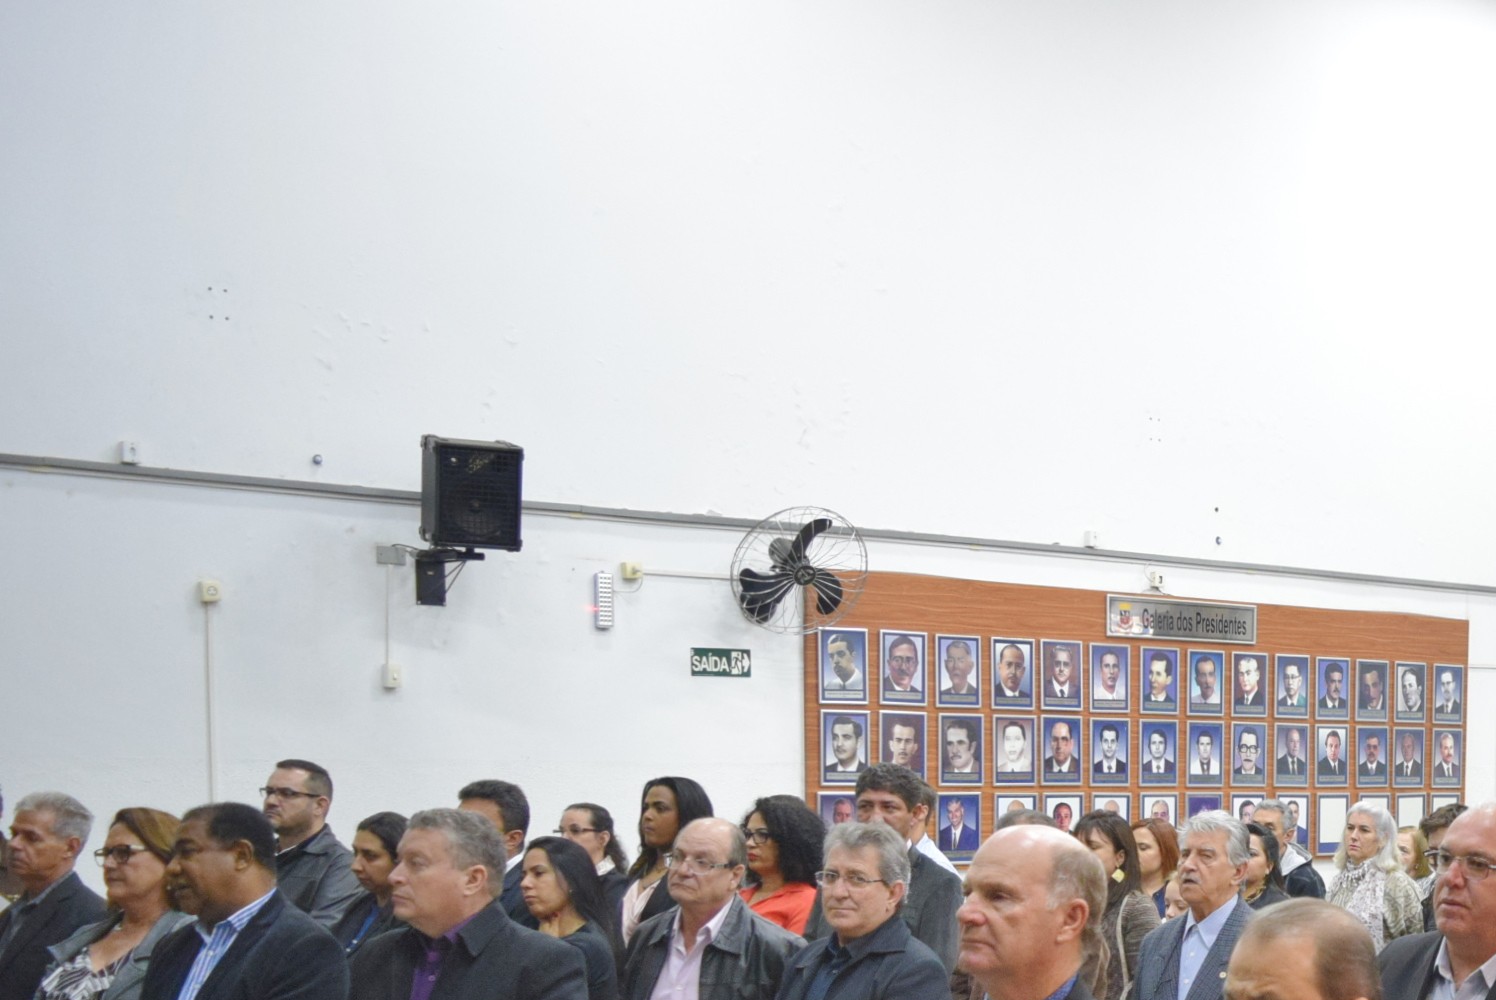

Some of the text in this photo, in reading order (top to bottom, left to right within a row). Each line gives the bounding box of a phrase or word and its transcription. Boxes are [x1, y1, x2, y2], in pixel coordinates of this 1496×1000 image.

[1142, 608, 1247, 636] Galeria dos Presidentes
[692, 652, 730, 672] SAÍDA
